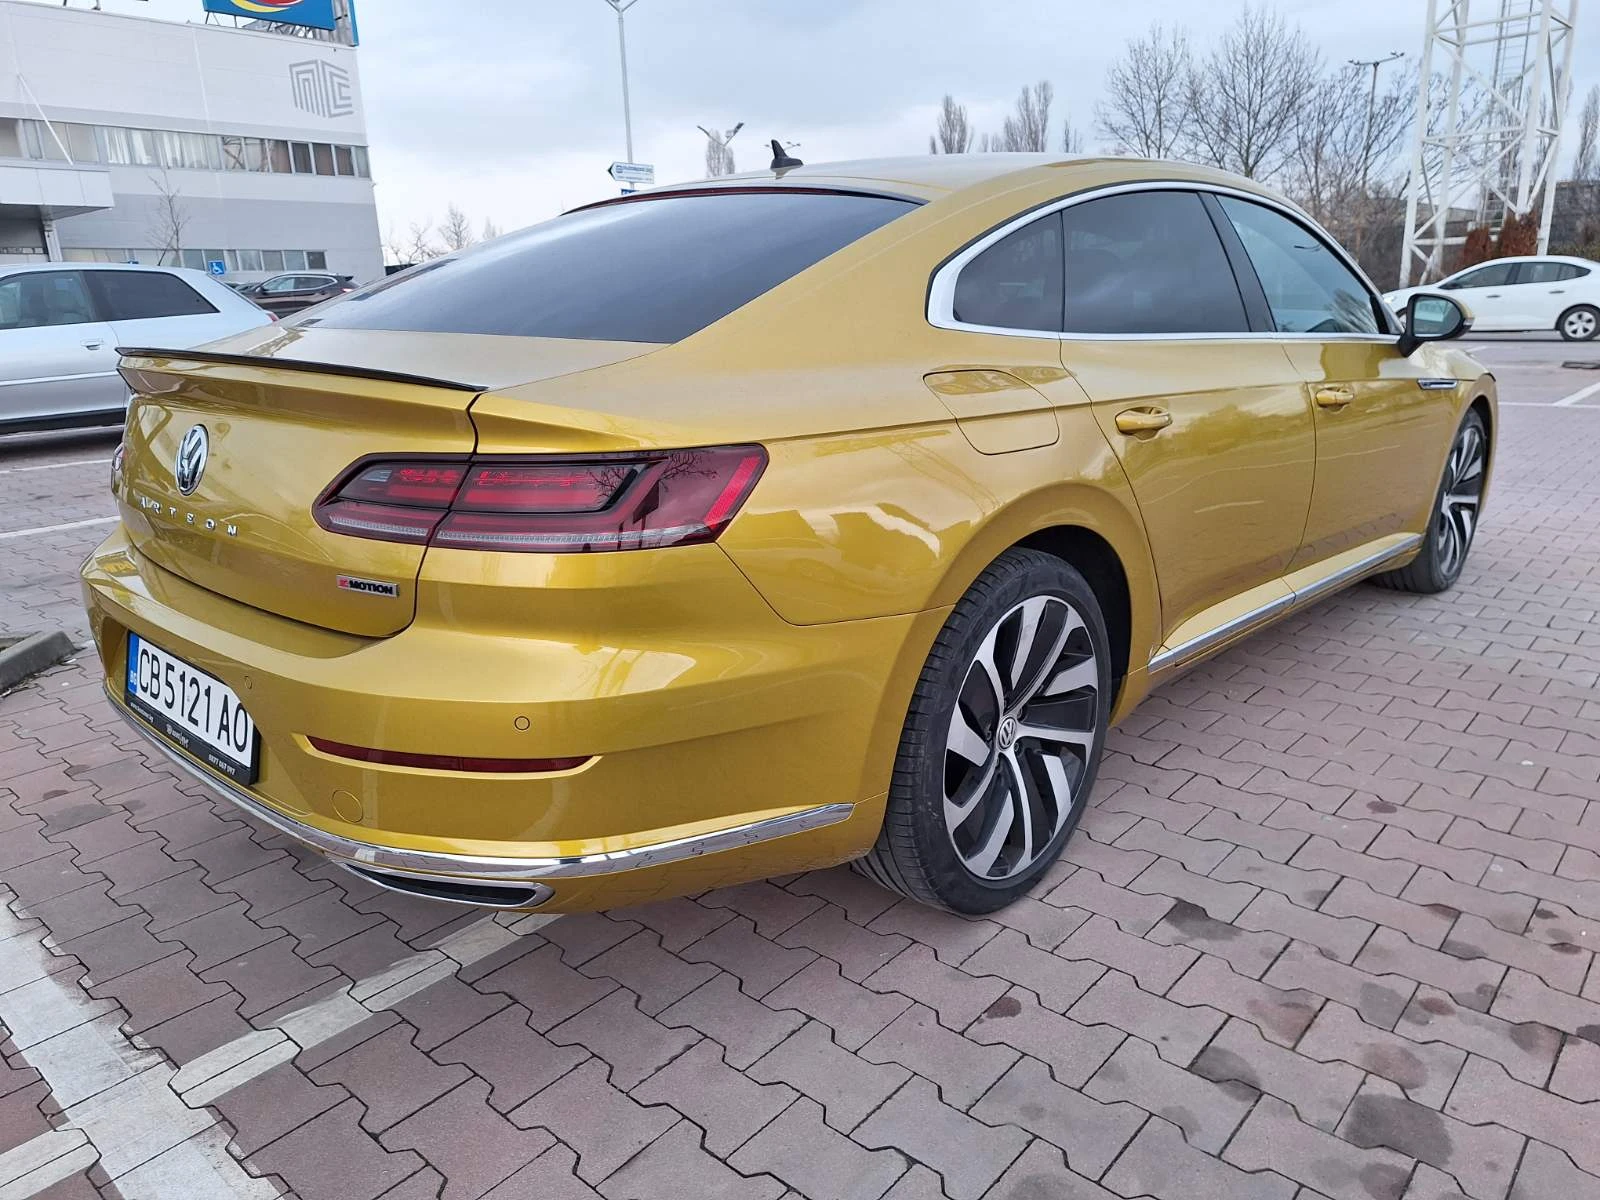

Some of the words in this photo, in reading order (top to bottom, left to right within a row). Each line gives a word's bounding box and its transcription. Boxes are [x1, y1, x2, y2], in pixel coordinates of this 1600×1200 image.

[139, 649, 160, 700] CB
[165, 662, 211, 733] 5121
[217, 694, 248, 752] AO
